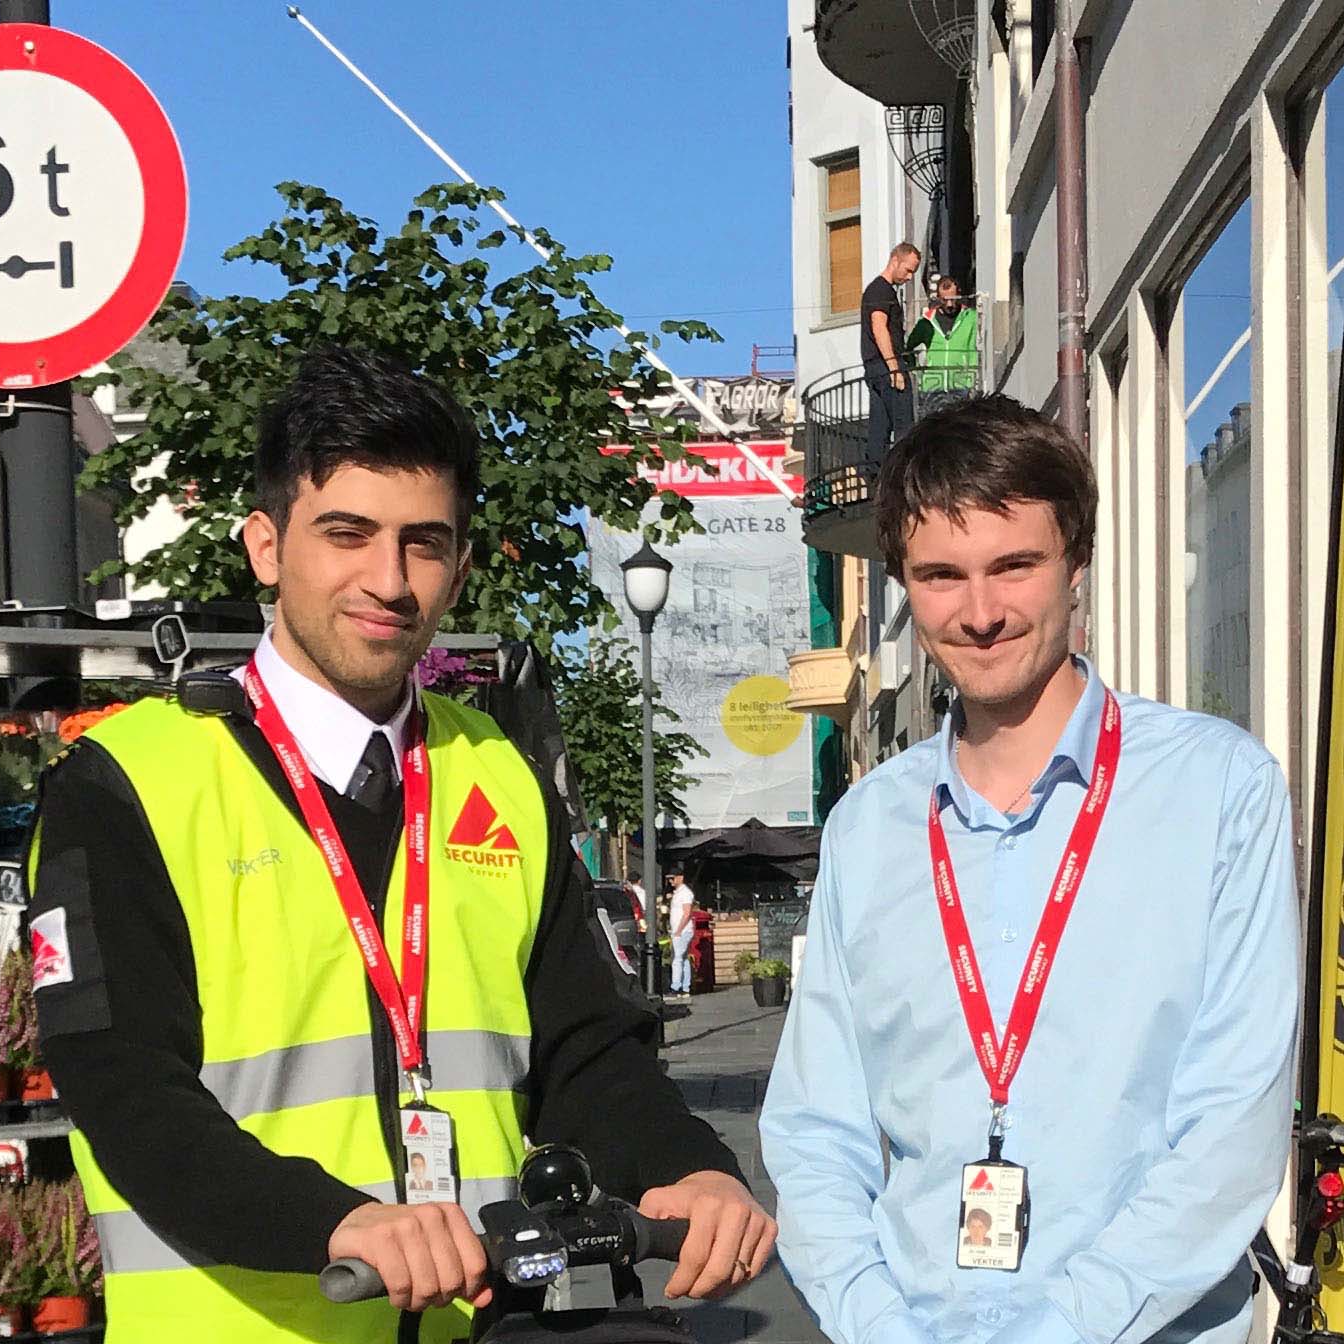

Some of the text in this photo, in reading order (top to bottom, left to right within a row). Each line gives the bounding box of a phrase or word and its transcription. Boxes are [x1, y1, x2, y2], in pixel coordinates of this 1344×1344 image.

[40, 144, 71, 217] t
[708, 517, 786, 535] GATE 28
[739, 701, 785, 714] leilighet
[1085, 763, 1107, 814] SECURITY
[415, 812, 425, 864] SECURITY
[443, 847, 525, 869] SECURITY
[937, 859, 955, 908] SECURITY
[1054, 850, 1079, 904] SECURITY
[411, 903, 424, 955] SECURITY
[958, 944, 978, 994] SECURITY
[1023, 941, 1048, 996] SECURITY
[998, 1032, 1019, 1086] SECURITY
